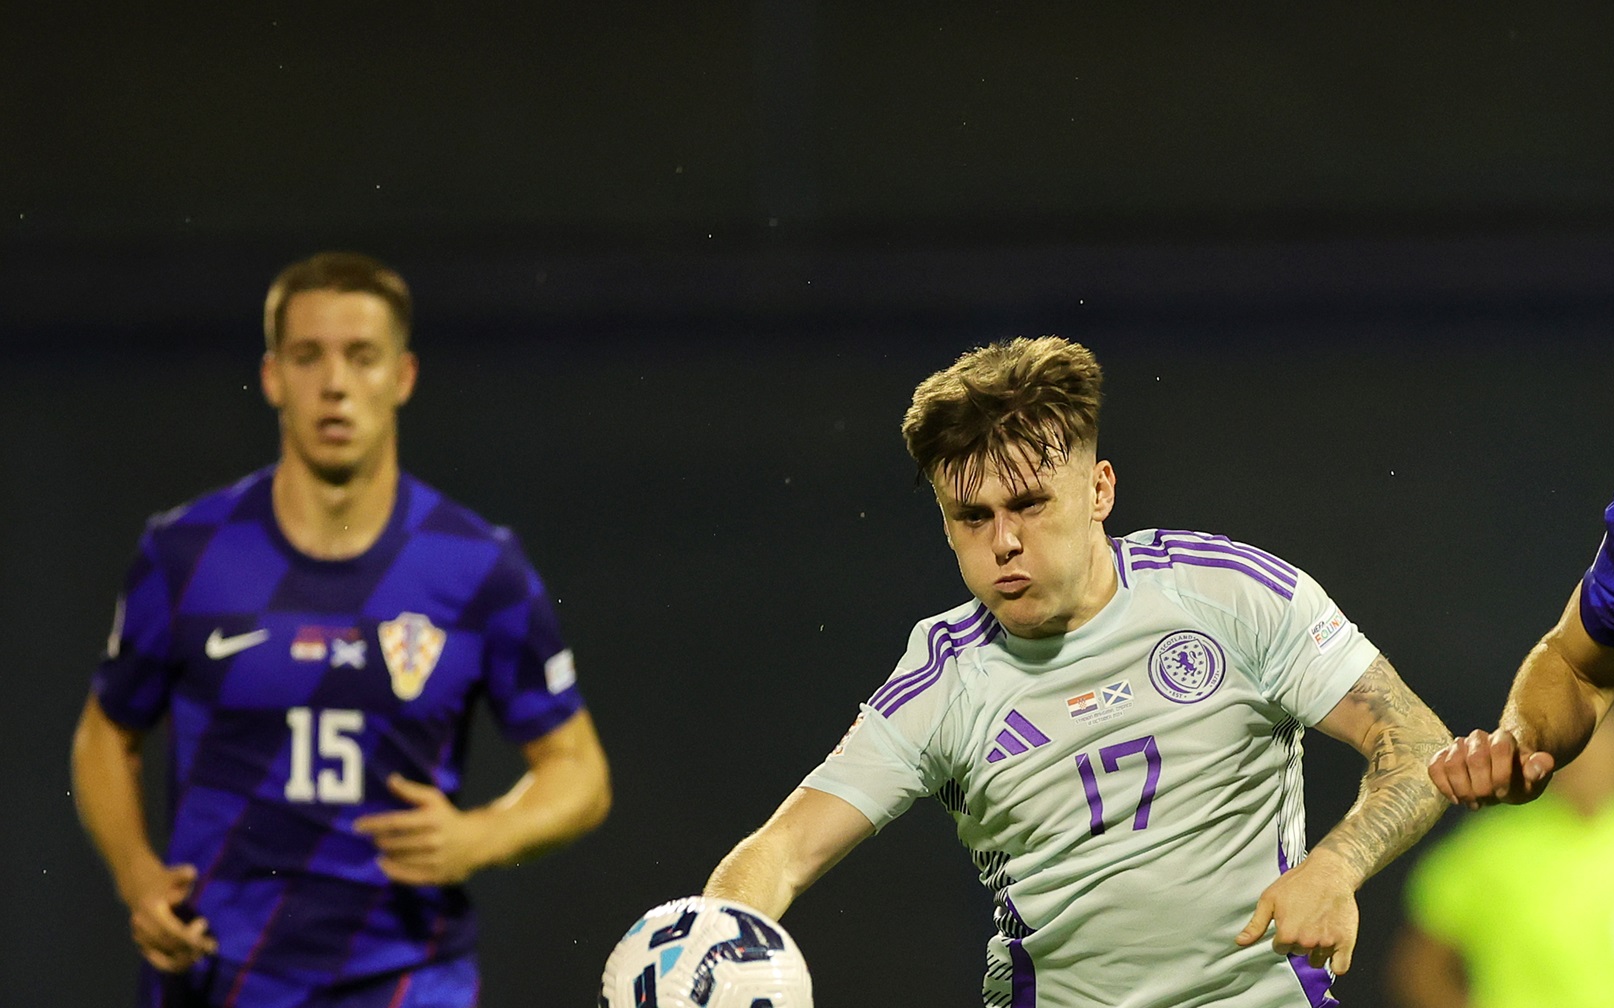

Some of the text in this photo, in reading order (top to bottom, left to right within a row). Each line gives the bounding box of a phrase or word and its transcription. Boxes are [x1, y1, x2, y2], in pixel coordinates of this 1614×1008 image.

[1311, 620, 1325, 635] UEFA
[1161, 634, 1194, 652] SCOTLAND
[1172, 691, 1183, 699] EST
[284, 706, 364, 804] 15
[1075, 735, 1162, 836] 17
